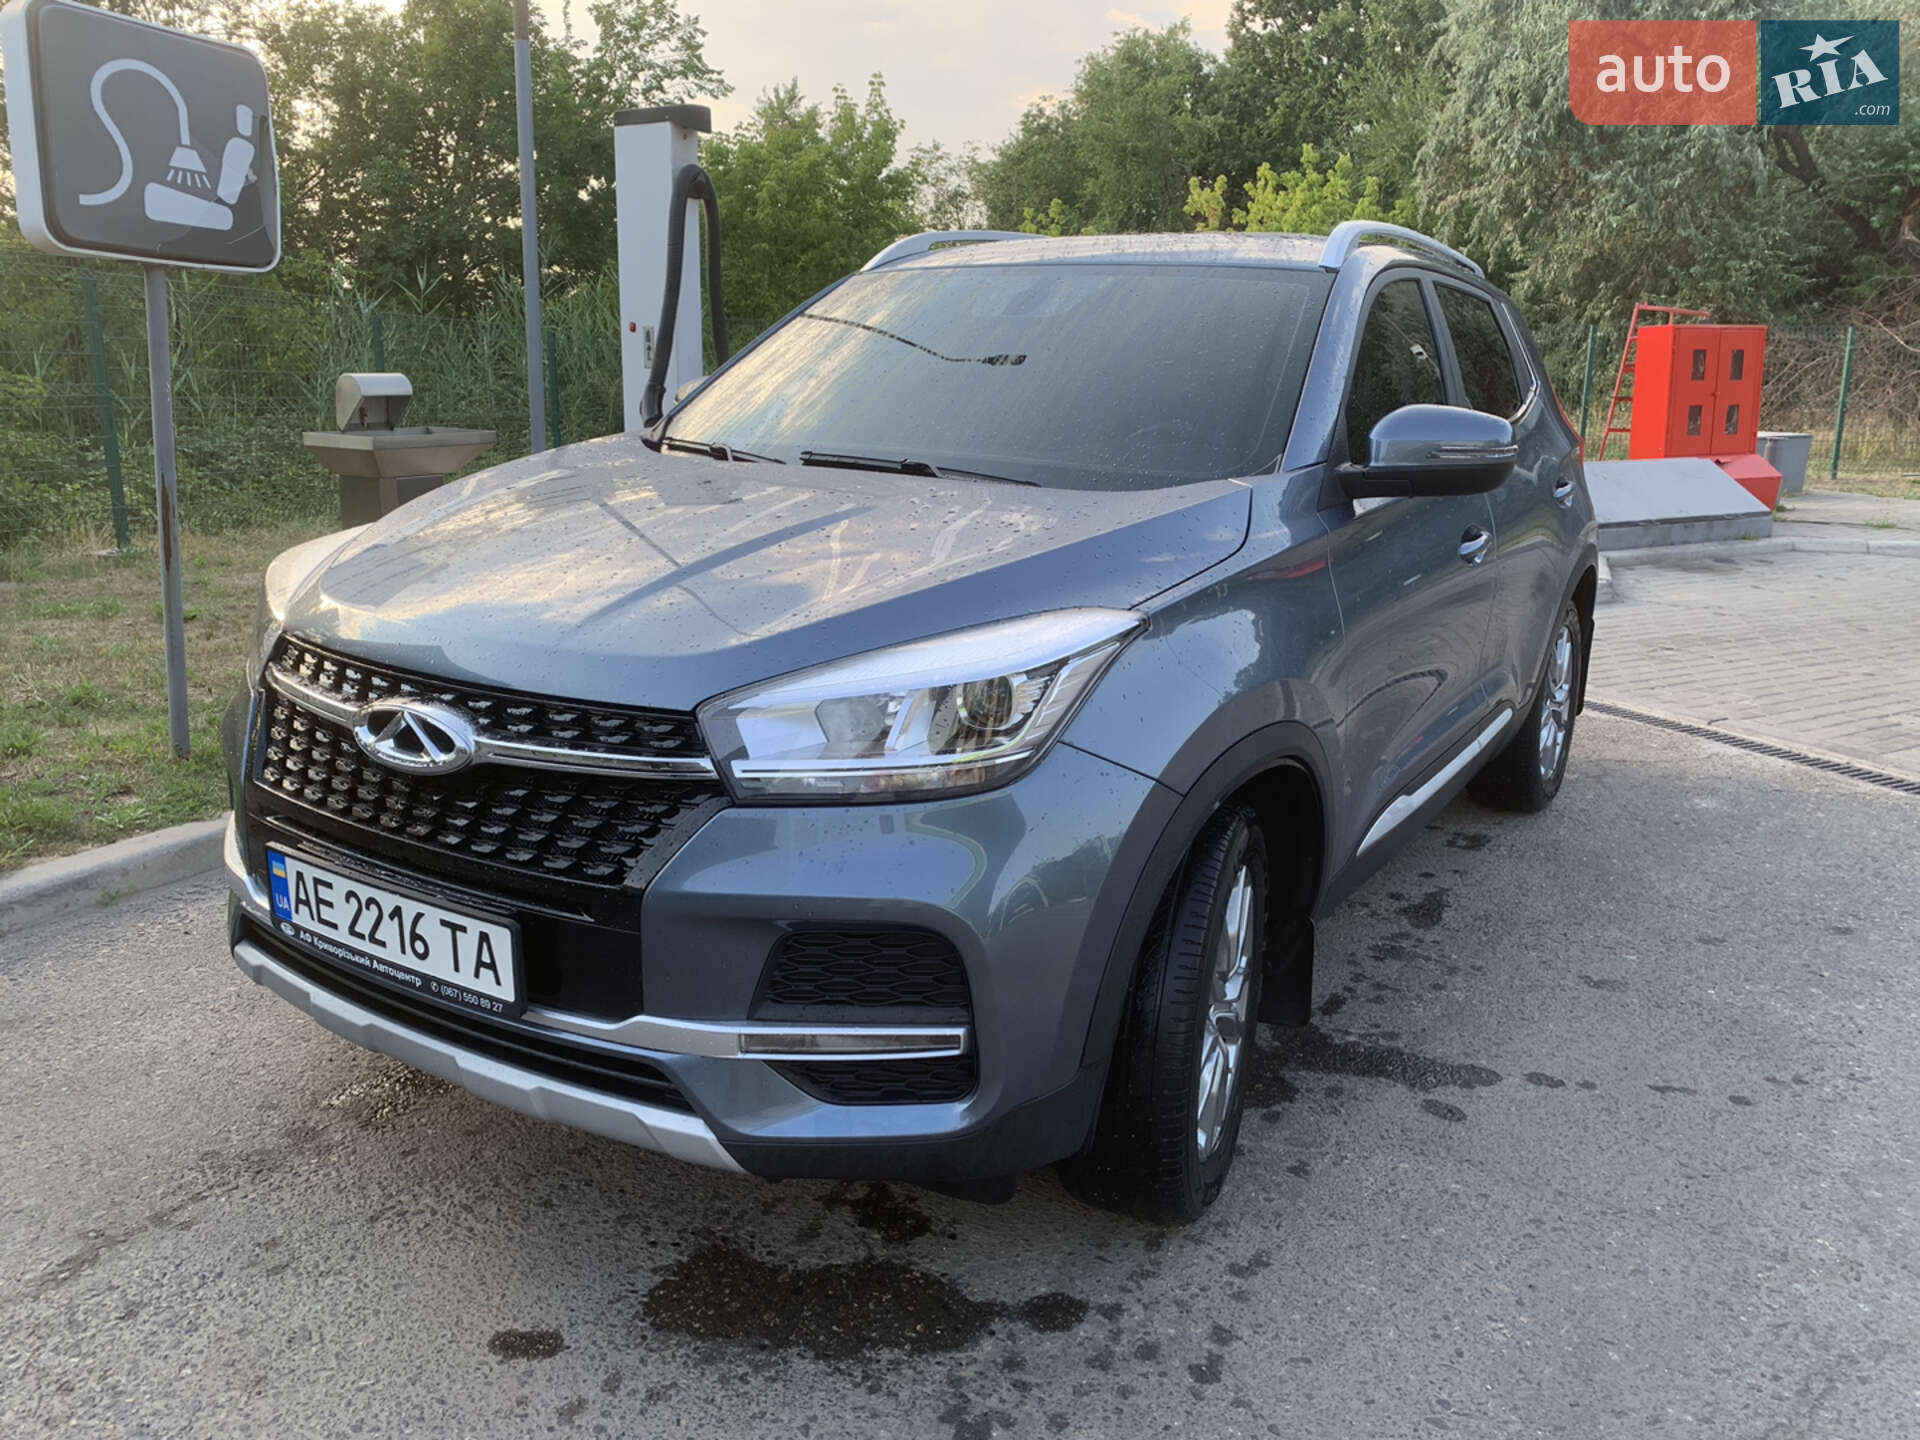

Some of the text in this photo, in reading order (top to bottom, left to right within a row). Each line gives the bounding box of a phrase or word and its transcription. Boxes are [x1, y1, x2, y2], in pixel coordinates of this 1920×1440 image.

[275, 893, 291, 911] UA
[294, 870, 503, 987] AE 2216 TA
[372, 959, 423, 988] Автоцентр
[491, 1001, 504, 1013] 27
